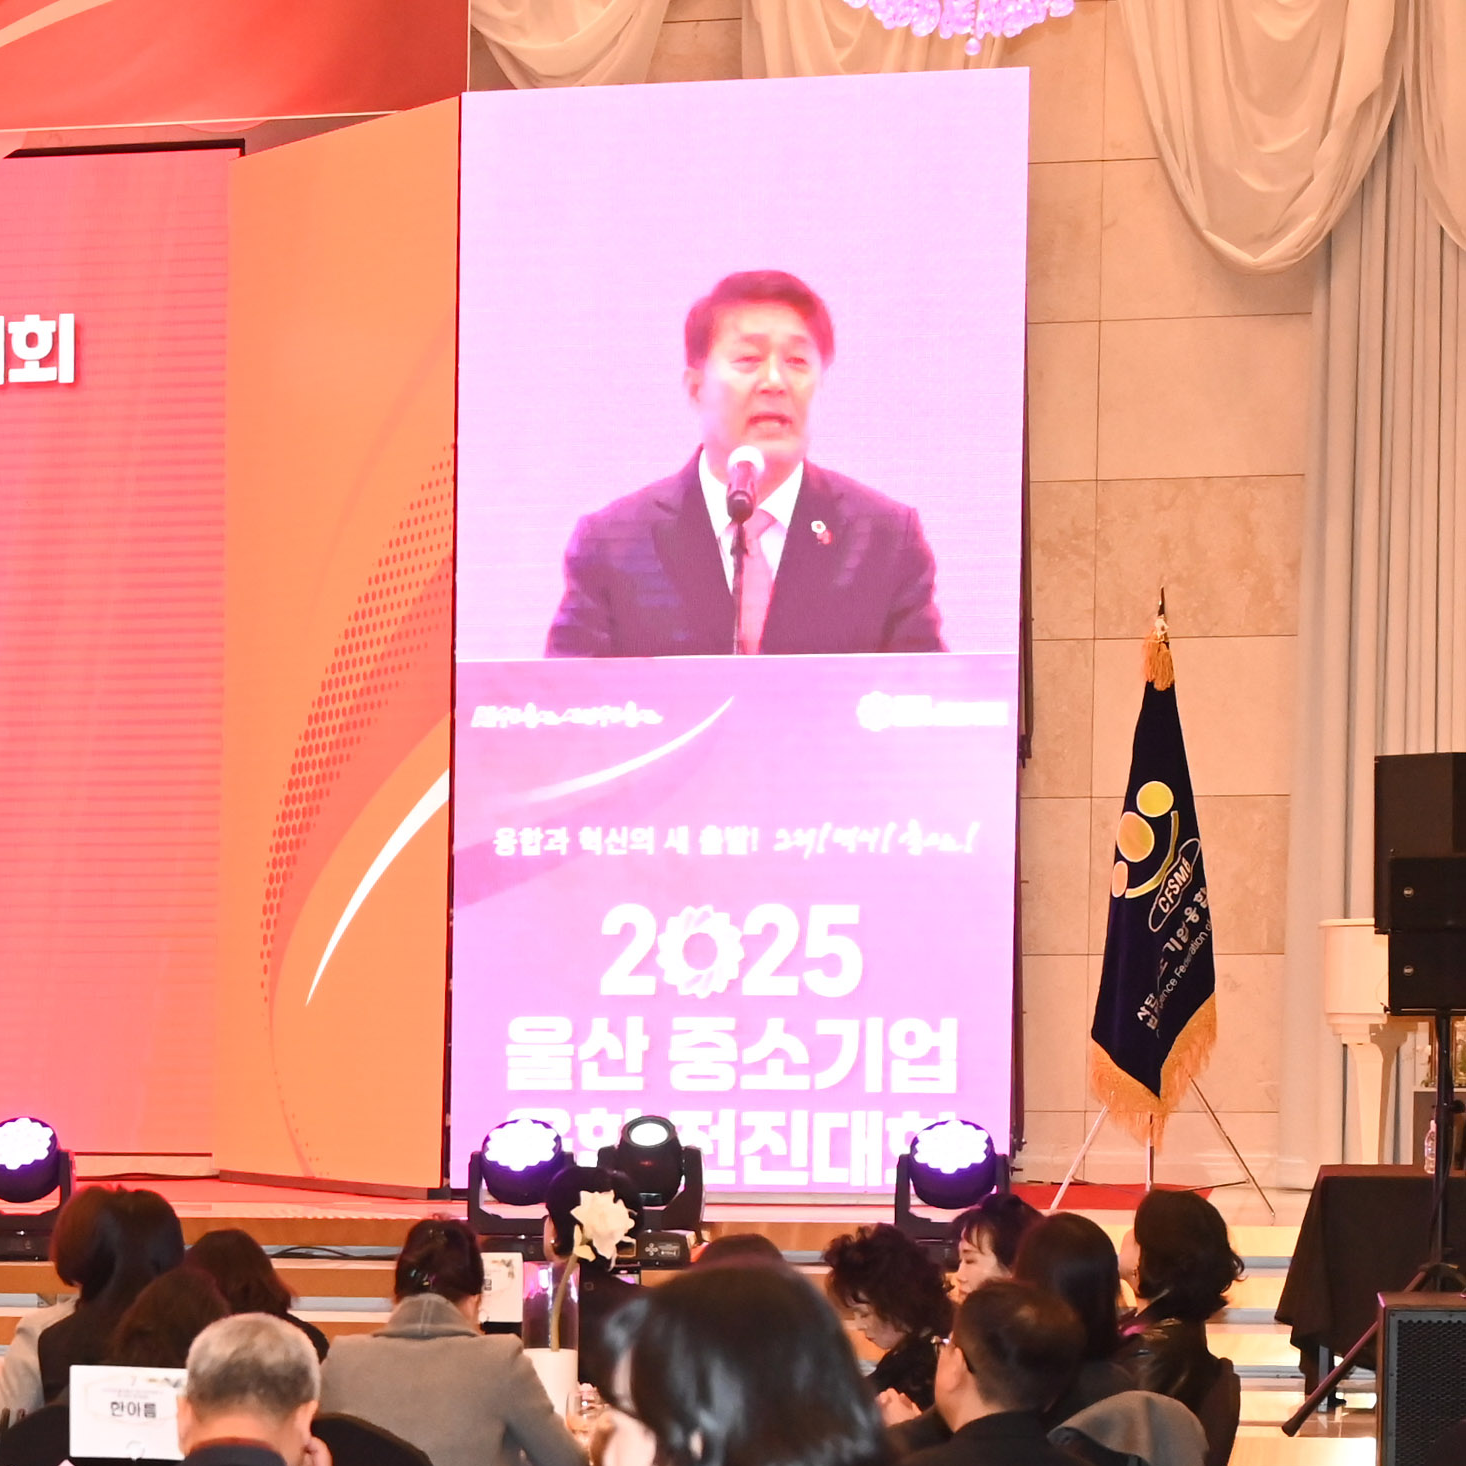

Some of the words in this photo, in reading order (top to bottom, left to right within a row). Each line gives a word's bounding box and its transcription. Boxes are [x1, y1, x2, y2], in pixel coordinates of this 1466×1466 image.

[494, 826, 569, 856] 융합과
[579, 826, 655, 855] 혁신의
[664, 825, 689, 855] 새
[698, 825, 760, 855] 출발!
[600, 903, 864, 999] 2025
[505, 1016, 650, 1091] 울산
[668, 1016, 958, 1094] 중소기업
